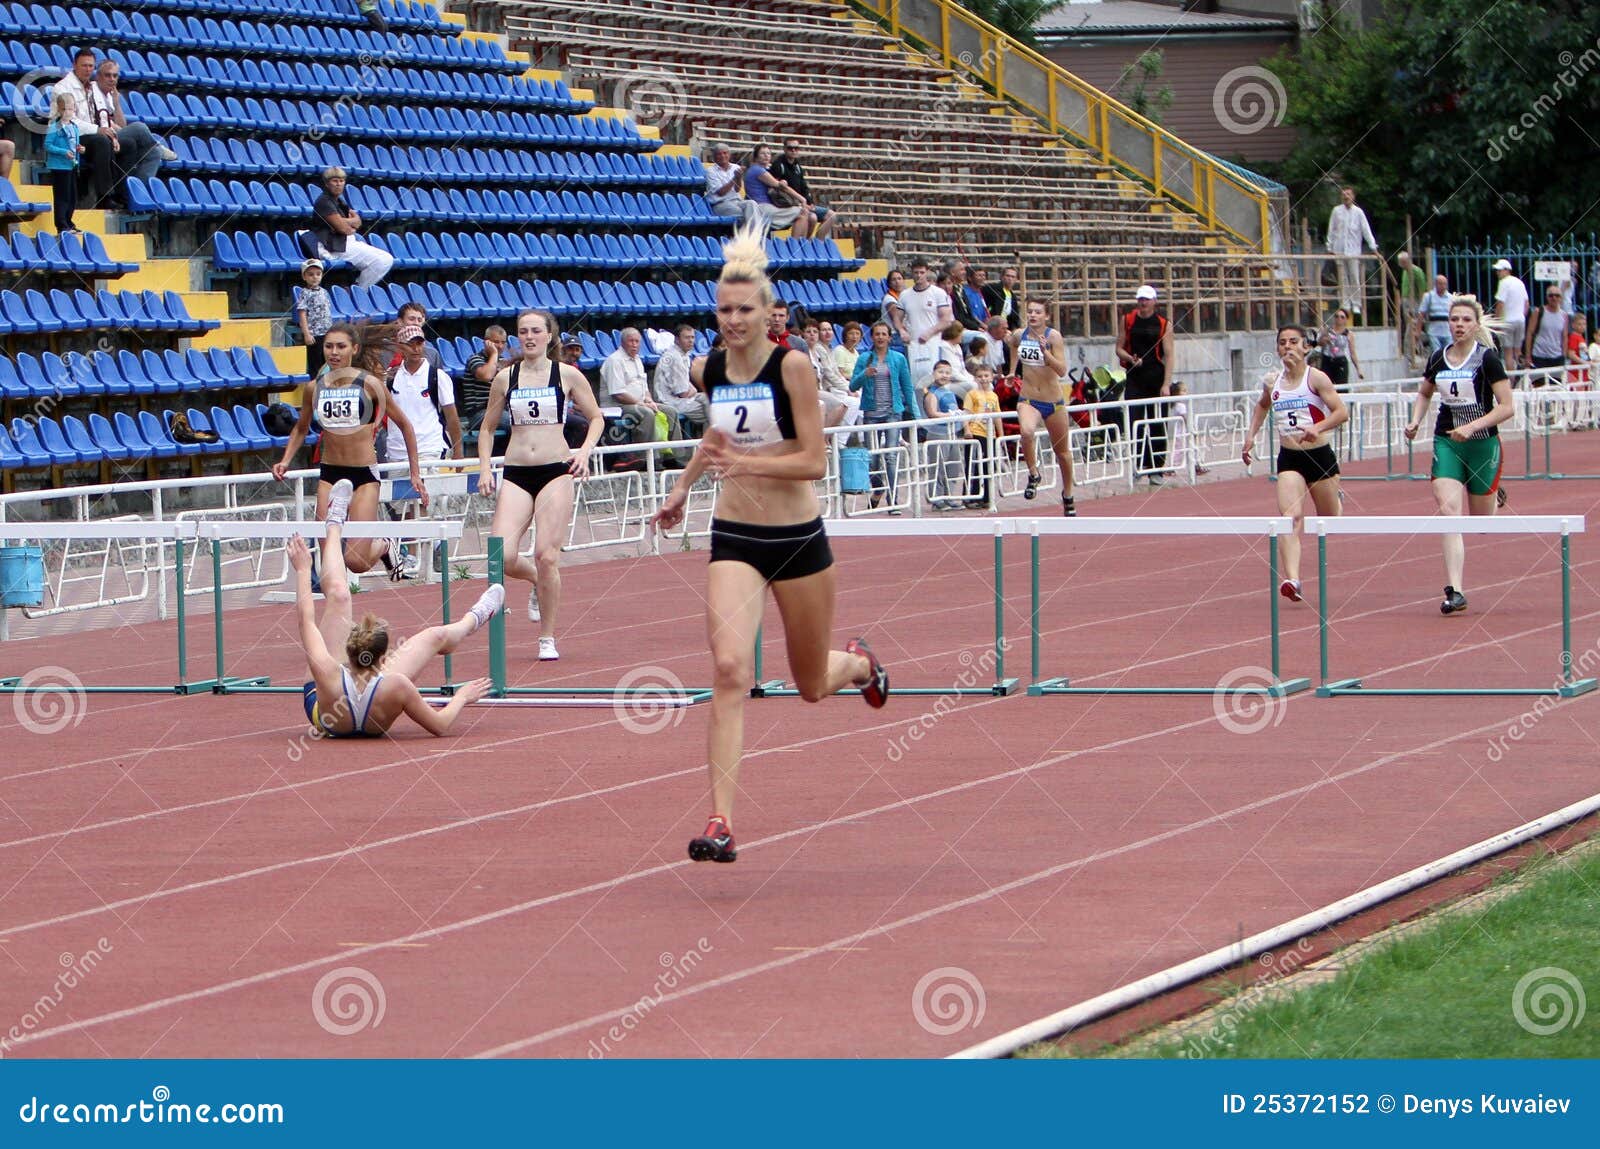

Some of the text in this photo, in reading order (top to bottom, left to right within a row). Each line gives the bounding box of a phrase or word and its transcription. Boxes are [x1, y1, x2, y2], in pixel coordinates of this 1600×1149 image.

[1021, 347, 1040, 361] 525
[319, 388, 360, 398] SAMSUNG
[511, 387, 556, 399] SAMSUNG
[713, 386, 772, 401] SAMSUNG
[1450, 381, 1459, 397] 4
[323, 400, 352, 418] 953
[528, 401, 540, 418] 3
[734, 405, 751, 433] 2
[1288, 412, 1297, 427] 5
